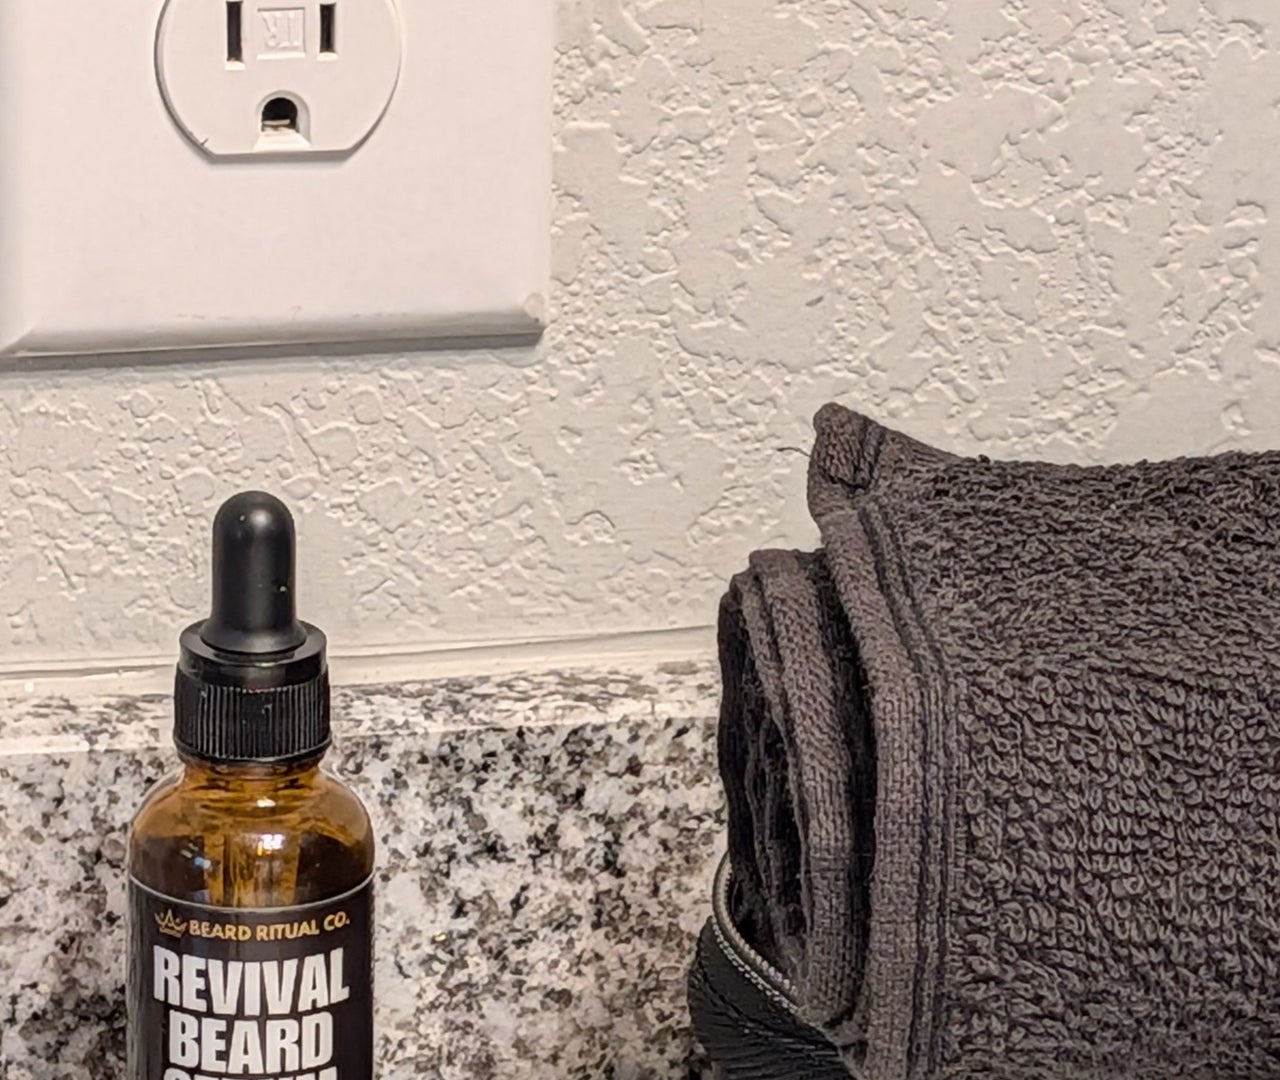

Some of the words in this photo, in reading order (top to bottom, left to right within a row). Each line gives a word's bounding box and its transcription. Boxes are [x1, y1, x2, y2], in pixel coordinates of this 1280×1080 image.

[189, 919, 251, 941] BEARD
[256, 919, 320, 941] RITUAL
[323, 911, 351, 932] CO.
[153, 945, 350, 1017] REVIVAL
[169, 1009, 333, 1074] BEARD
